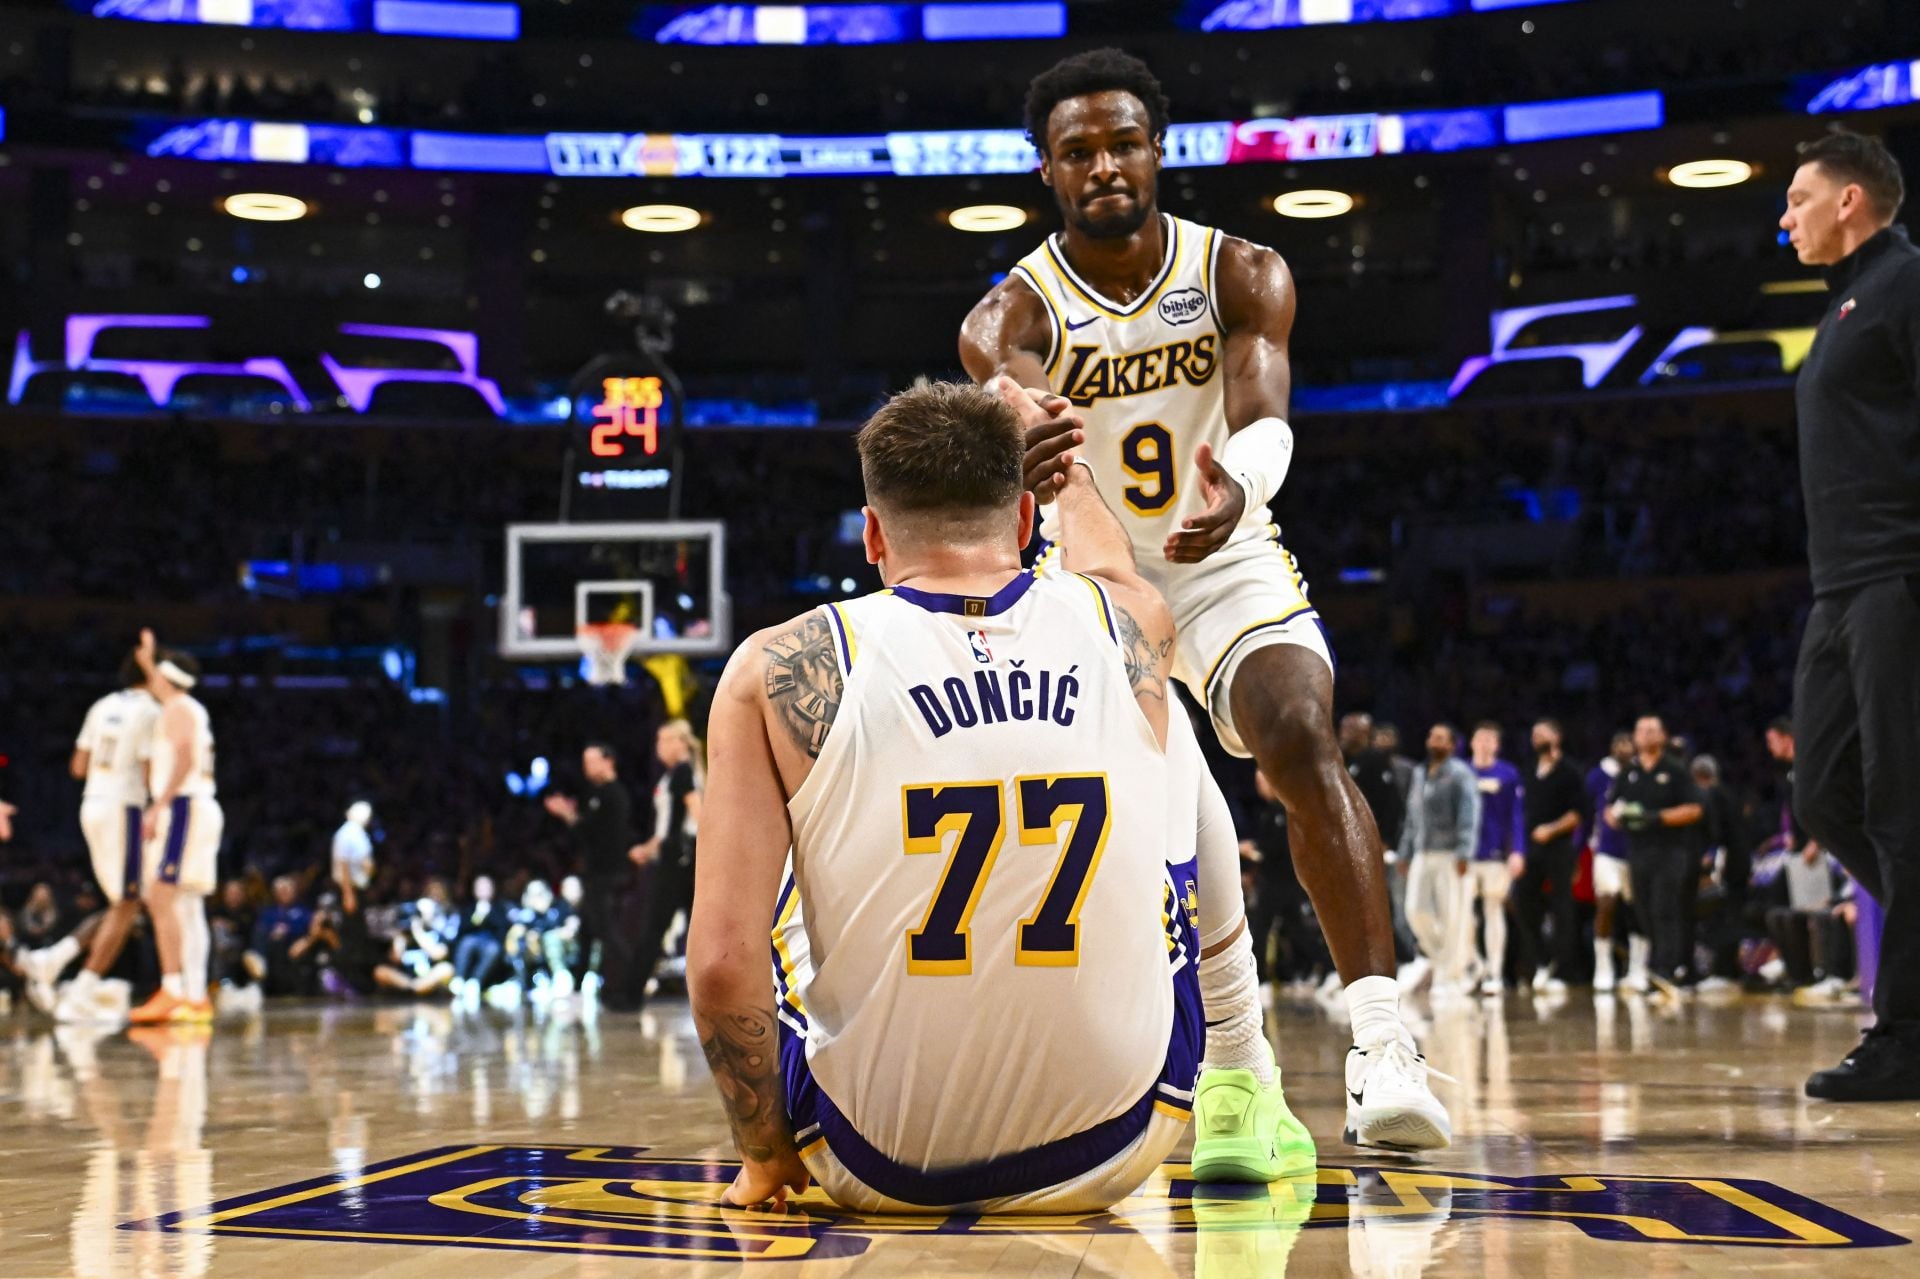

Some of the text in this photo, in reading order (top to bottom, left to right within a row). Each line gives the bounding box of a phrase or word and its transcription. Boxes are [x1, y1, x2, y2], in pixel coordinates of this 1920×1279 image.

[1162, 297, 1204, 314] bibigo
[1058, 333, 1218, 409] LAKERS
[591, 404, 657, 456] 24
[1119, 420, 1178, 518] 9
[908, 659, 1079, 738] DONČIĆ
[901, 771, 1112, 976] 77
